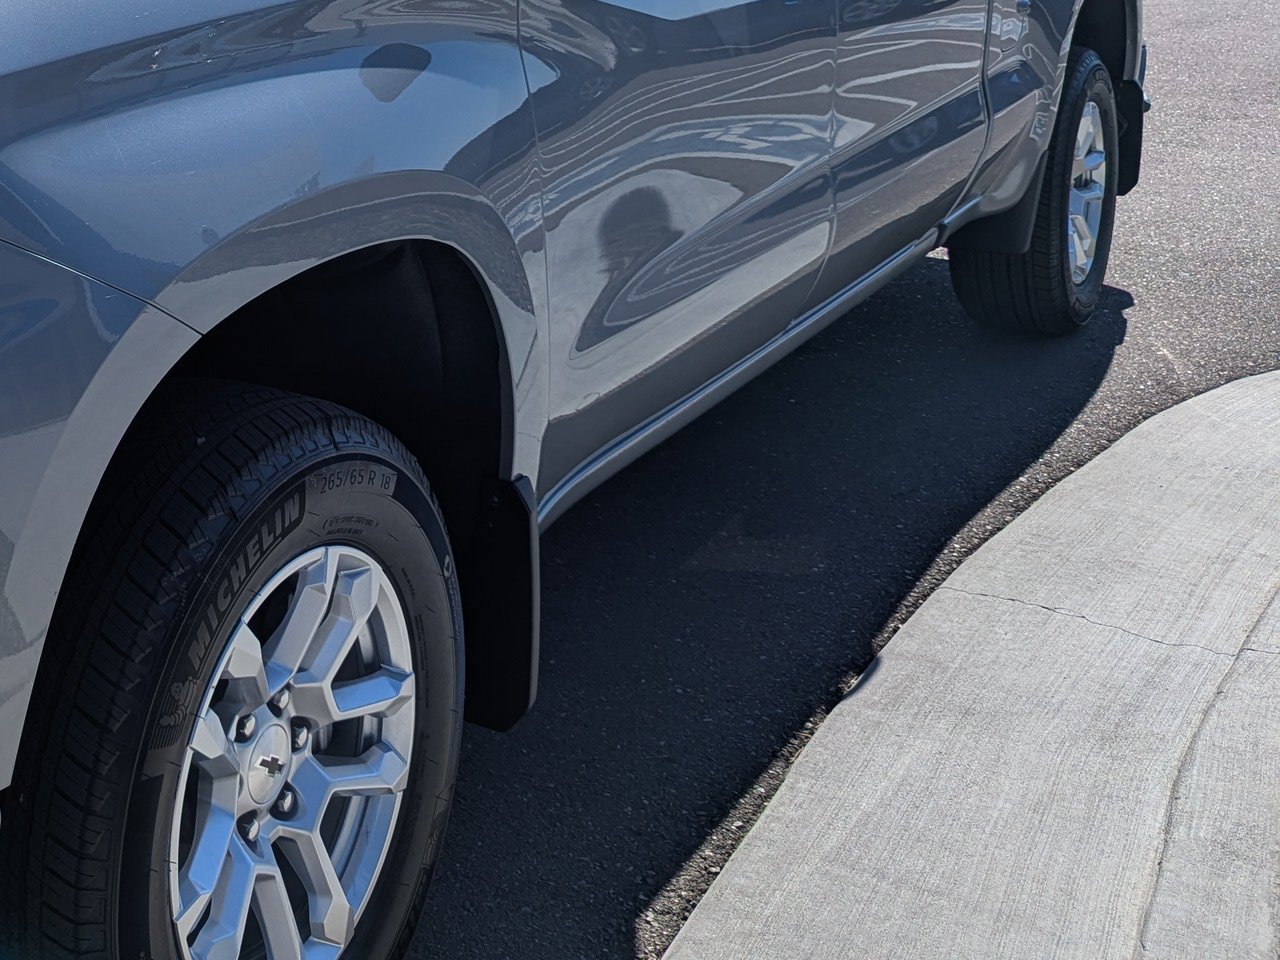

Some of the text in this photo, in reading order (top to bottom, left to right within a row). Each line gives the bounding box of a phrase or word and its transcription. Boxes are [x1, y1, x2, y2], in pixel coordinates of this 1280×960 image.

[320, 469, 392, 494] 265/65 R 18
[188, 492, 300, 671] MICHELIN
